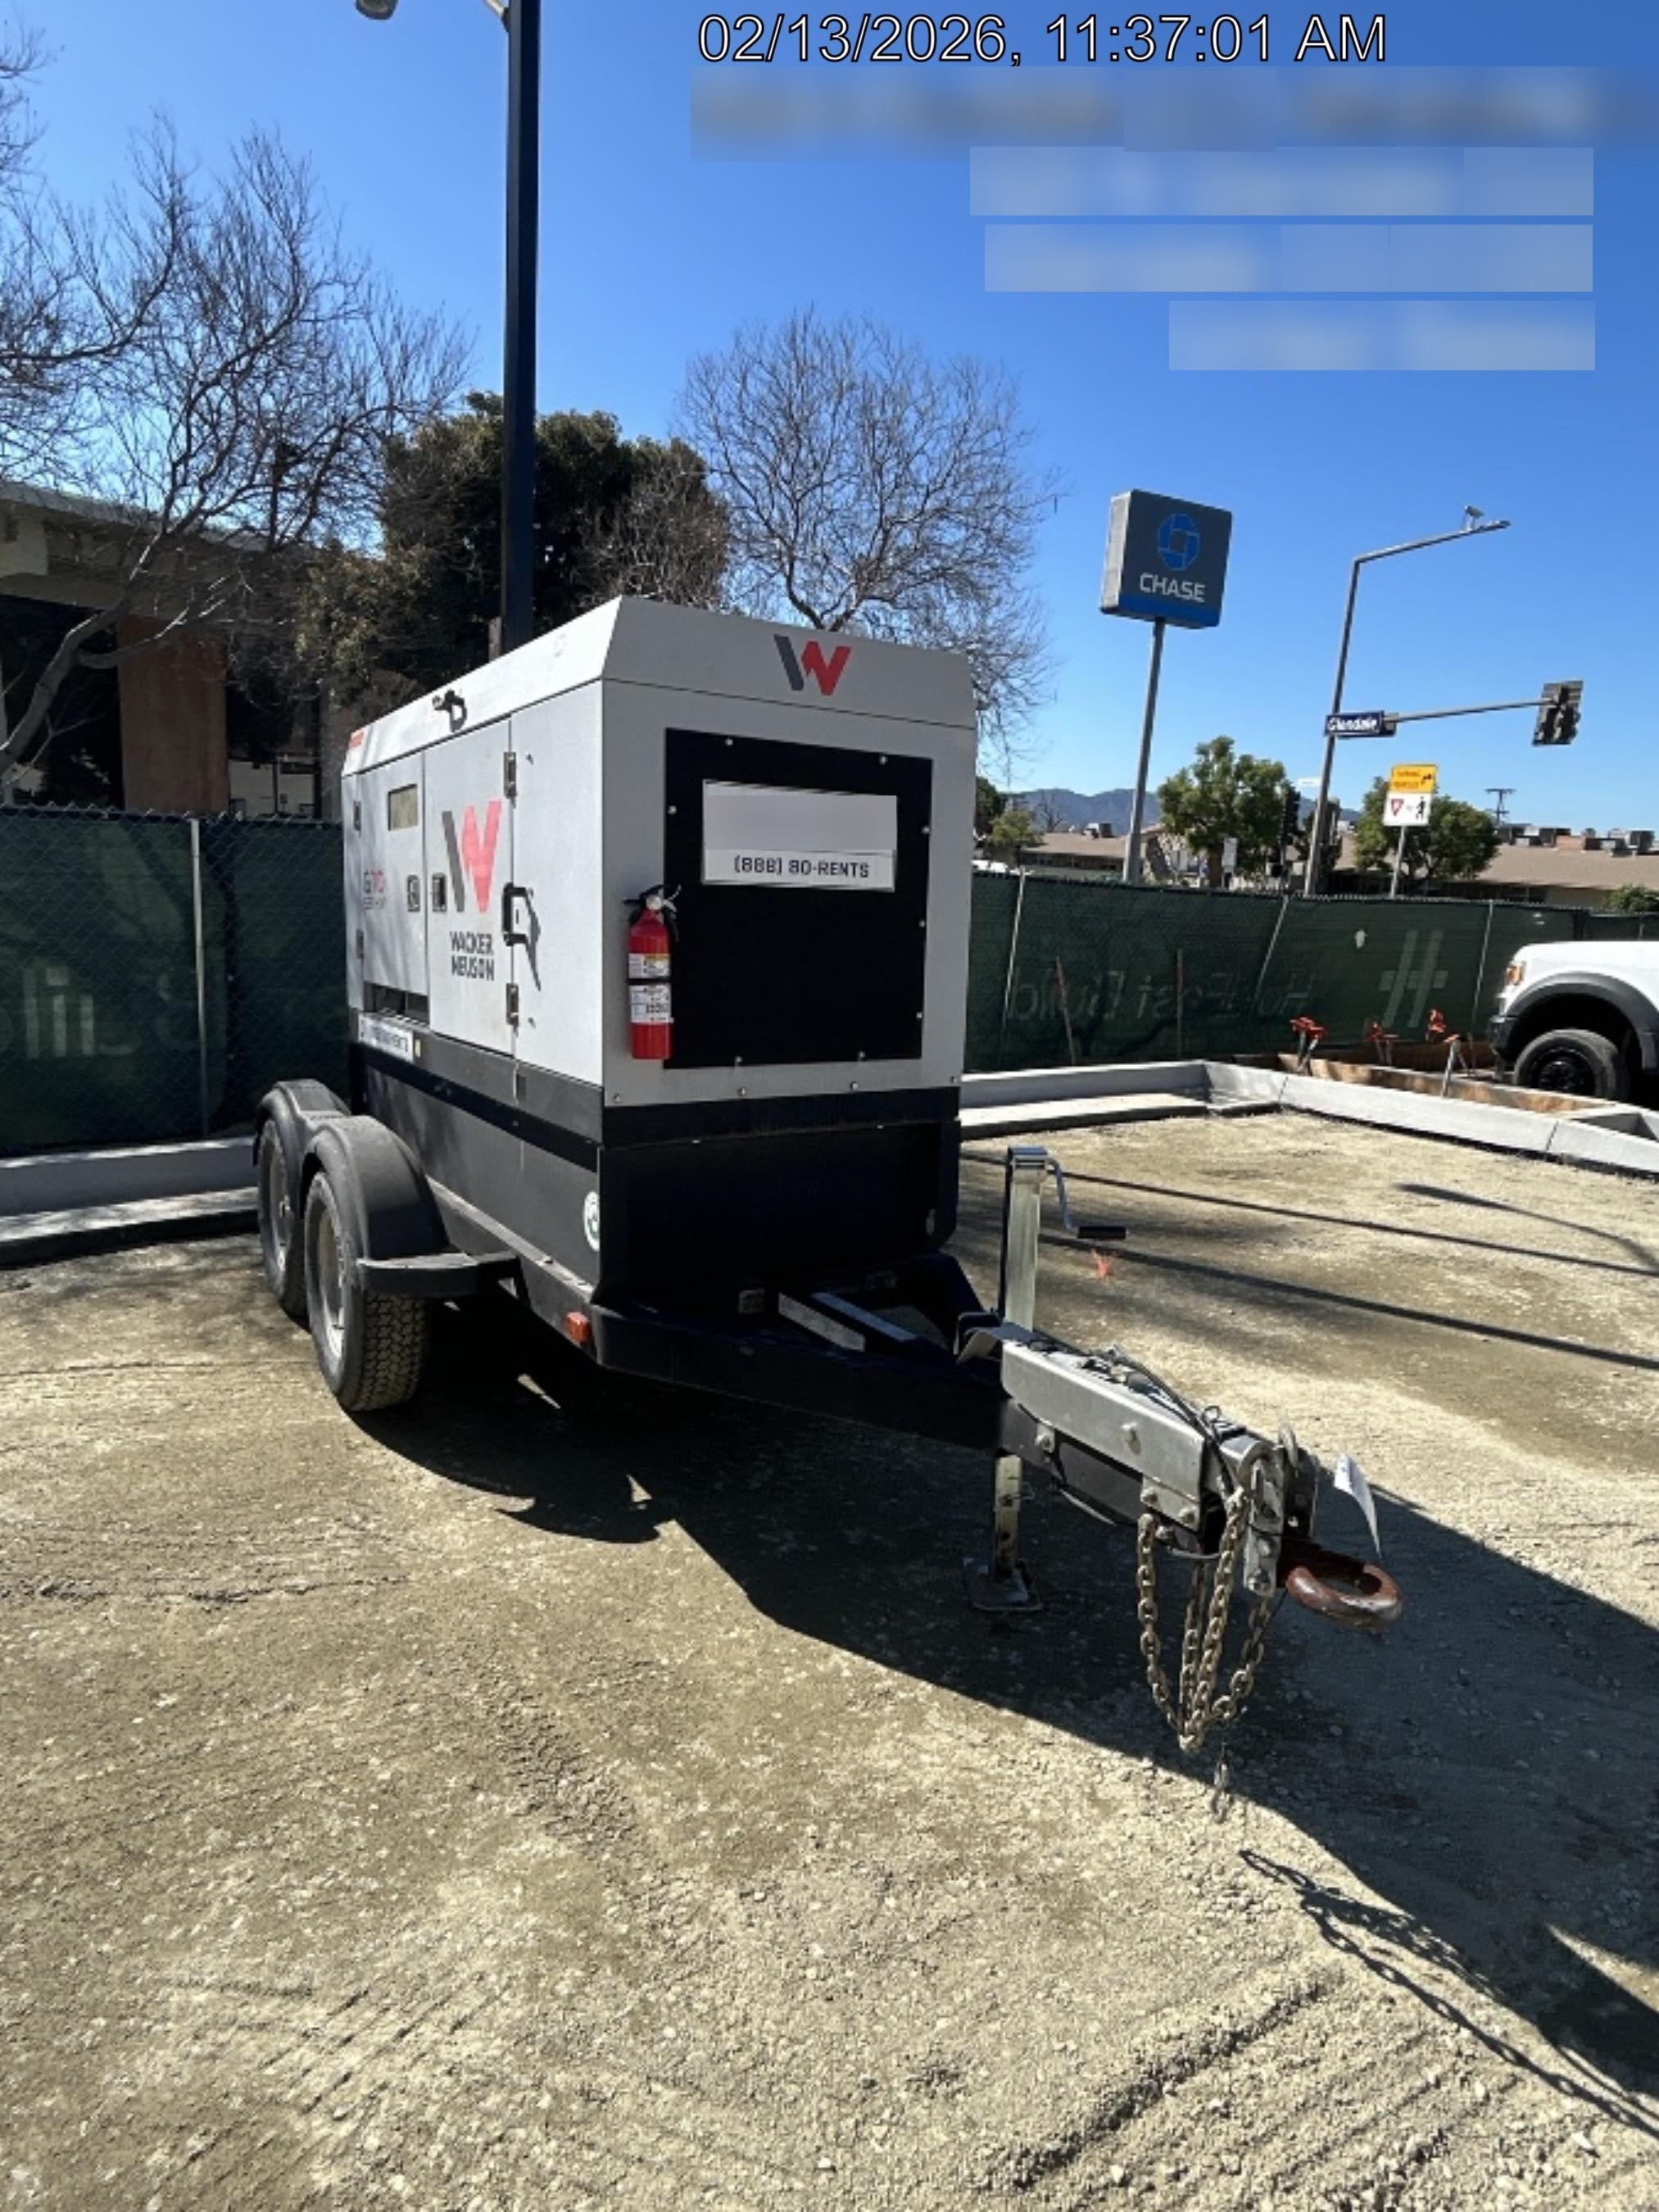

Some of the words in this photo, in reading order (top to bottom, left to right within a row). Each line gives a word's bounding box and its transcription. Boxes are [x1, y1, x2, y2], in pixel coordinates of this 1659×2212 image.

[1140, 571, 1206, 603] CHASE
[450, 931, 493, 955] WACKER
[451, 955, 494, 981] NEUSON
